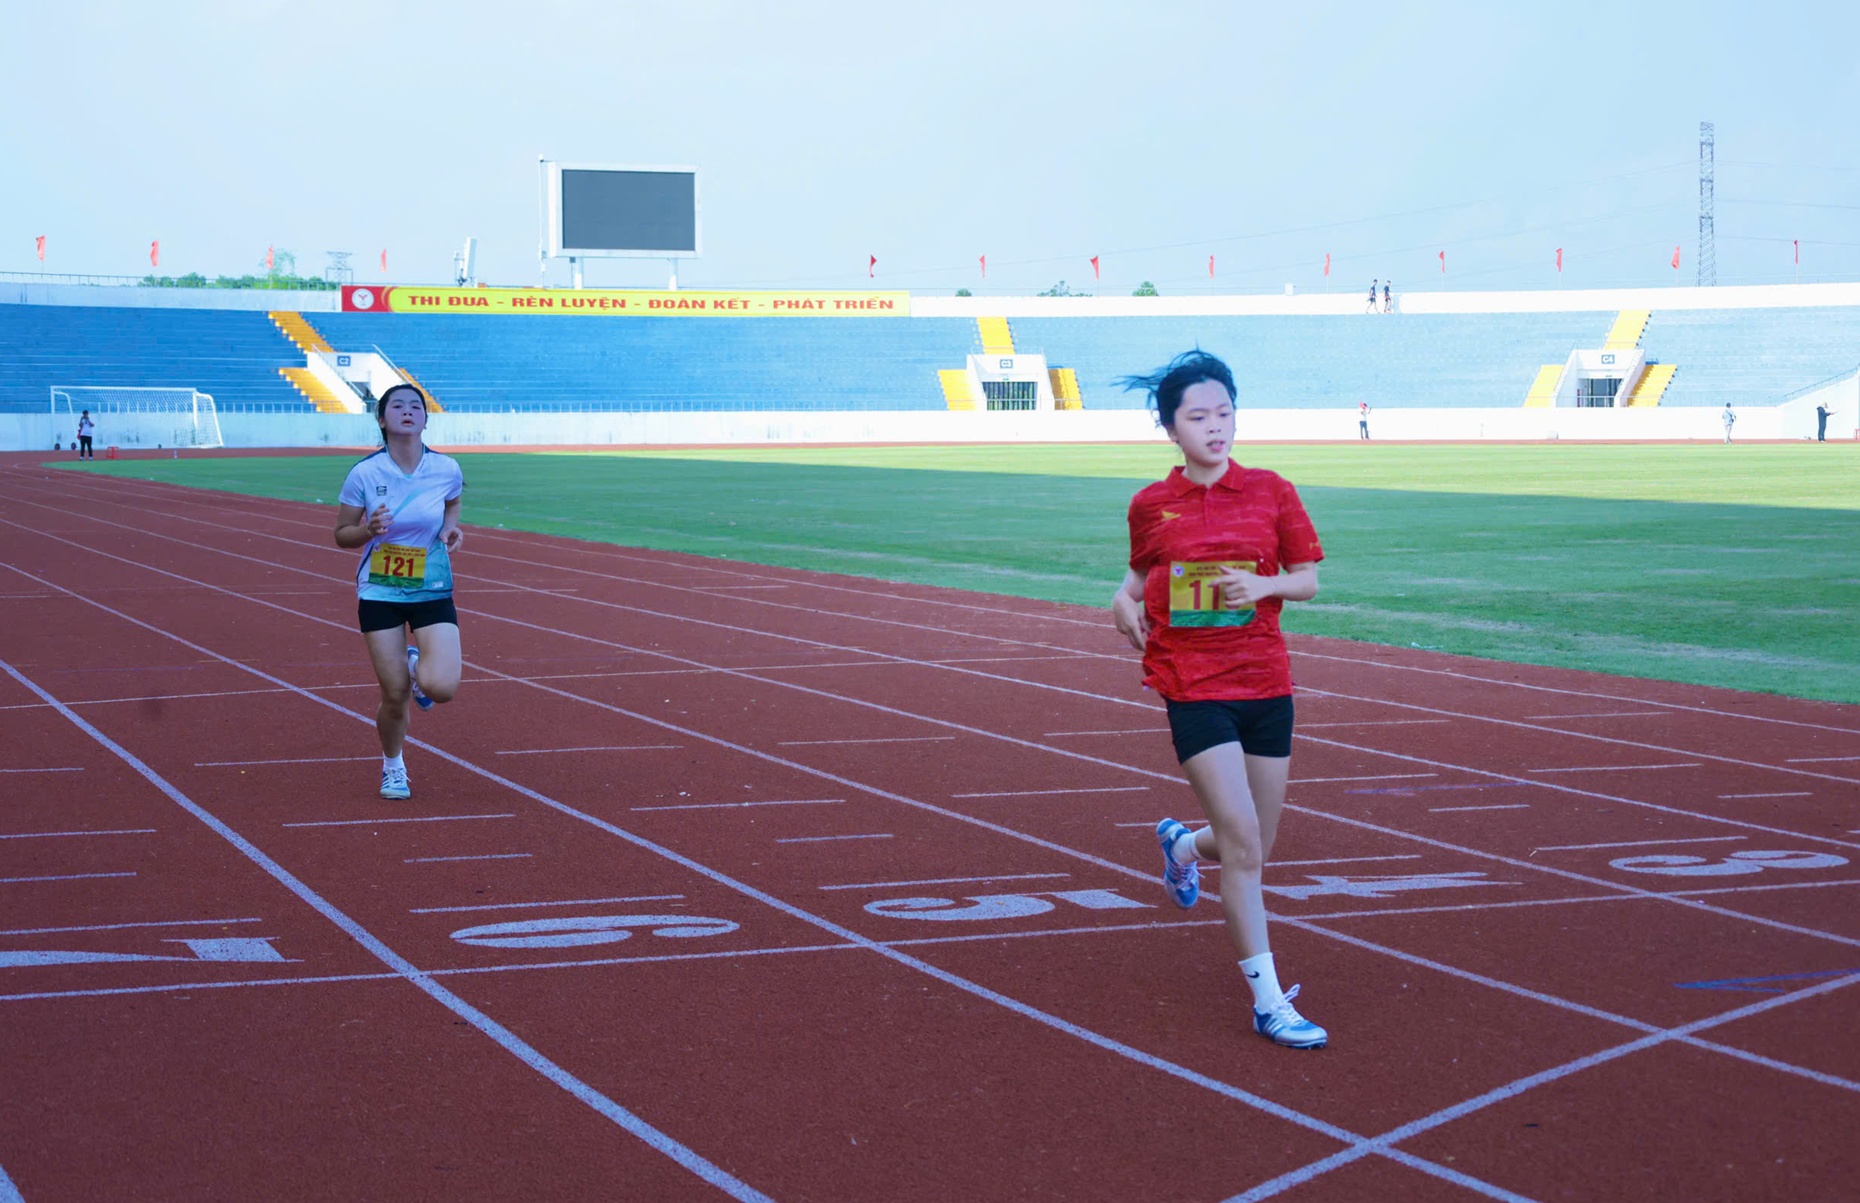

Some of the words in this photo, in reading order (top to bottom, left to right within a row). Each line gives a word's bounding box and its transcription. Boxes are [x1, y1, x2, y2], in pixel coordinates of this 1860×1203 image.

[408, 295, 441, 306] THI
[448, 296, 489, 307] ĐUA
[511, 295, 553, 307] RÈN
[561, 296, 626, 310] LUYỆN
[648, 297, 706, 309] ĐOÀN
[713, 296, 751, 309] KẾT
[772, 297, 826, 309] PHÁT
[339, 357, 349, 365] C2
[1602, 355, 1613, 363] C4
[383, 555, 414, 577] 121
[1607, 850, 1851, 877] 3
[862, 888, 1158, 921] 5
[449, 914, 740, 949] 6
